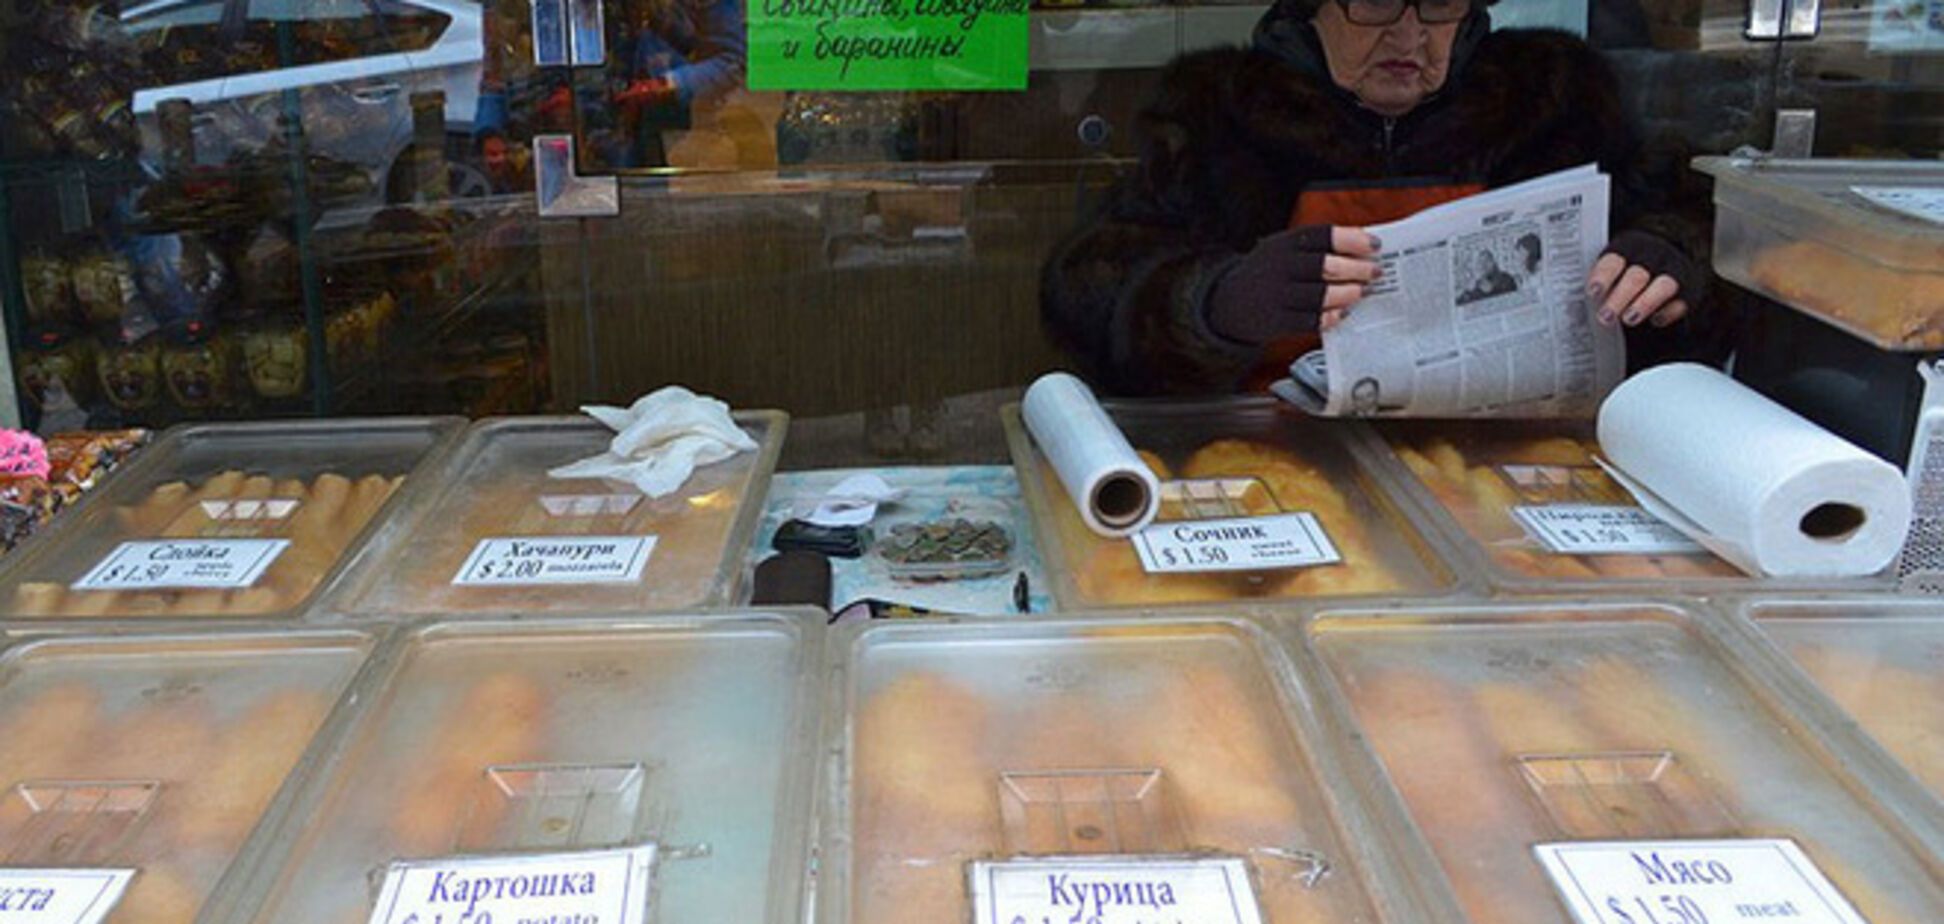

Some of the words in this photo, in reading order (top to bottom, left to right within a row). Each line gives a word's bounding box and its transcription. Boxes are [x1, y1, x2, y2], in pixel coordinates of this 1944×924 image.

[782, 40, 799, 59] и
[1174, 525, 1268, 543] Сочник
[149, 544, 231, 560] Слойка
[504, 542, 616, 560] Хачапури
[1631, 852, 1733, 884] Мясо
[0, 888, 55, 911] ста
[428, 871, 596, 915] Картошка
[1048, 874, 1176, 922] Курица
[1736, 900, 1801, 917] meat
